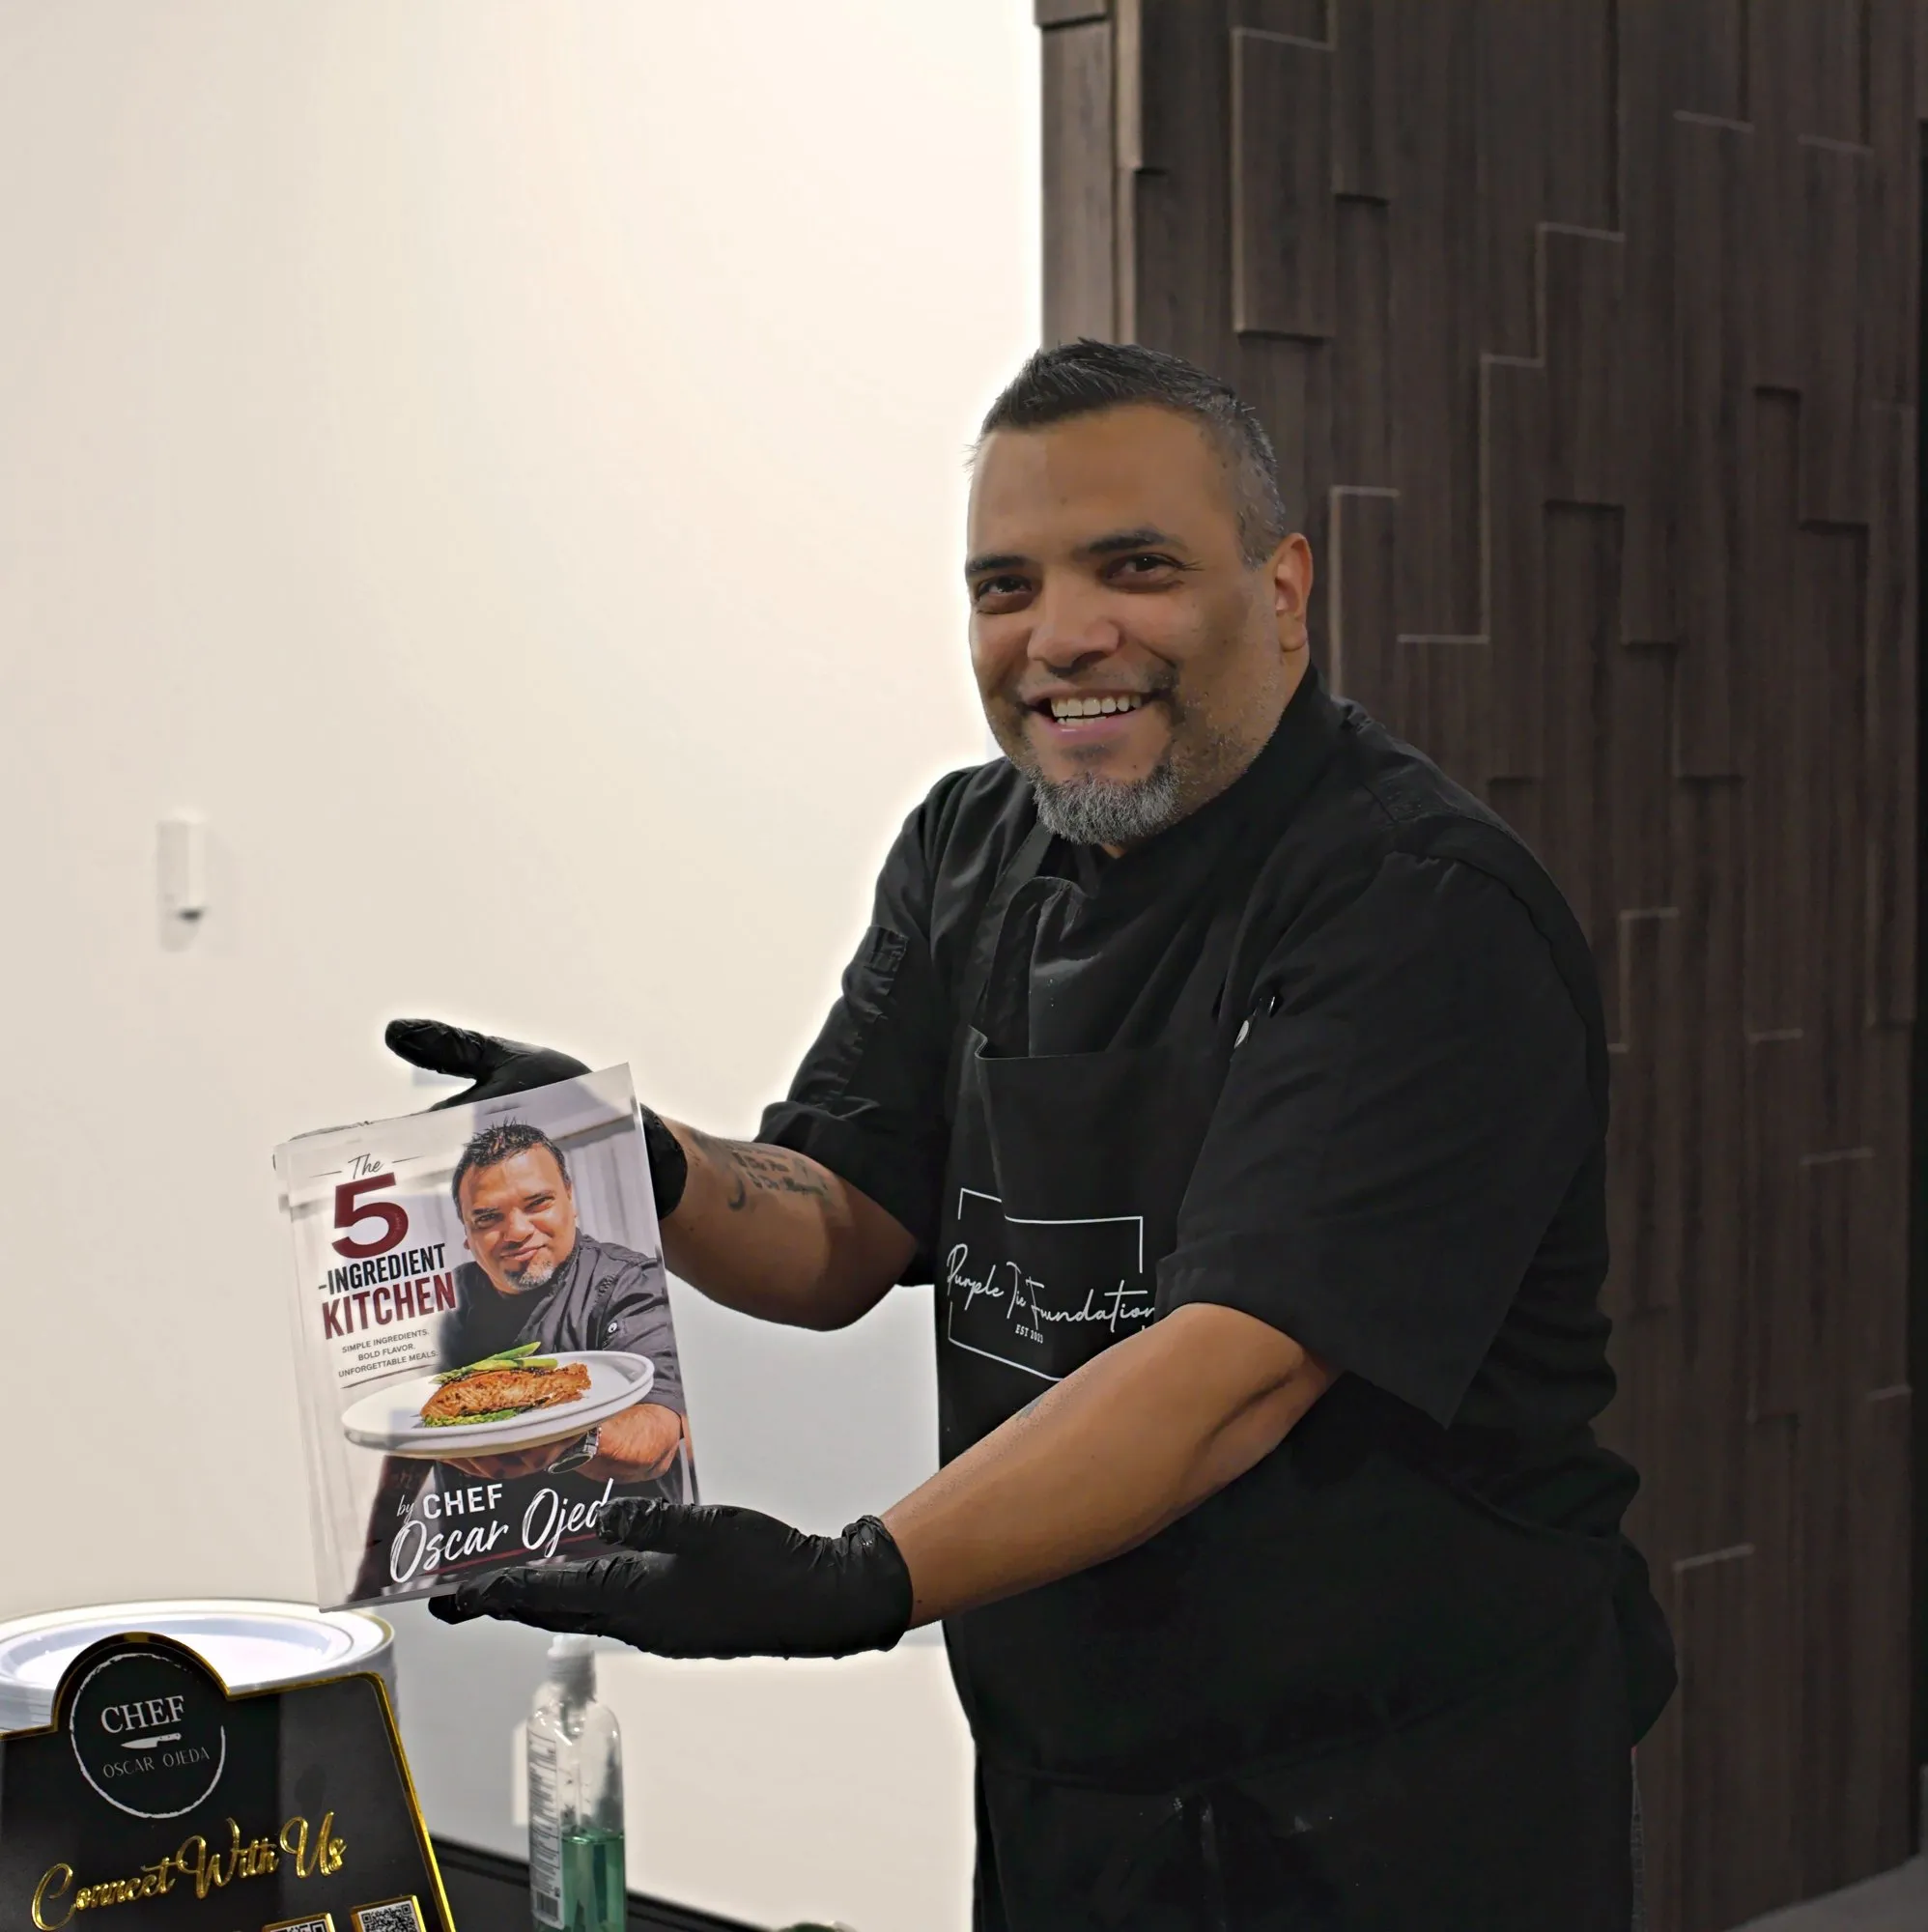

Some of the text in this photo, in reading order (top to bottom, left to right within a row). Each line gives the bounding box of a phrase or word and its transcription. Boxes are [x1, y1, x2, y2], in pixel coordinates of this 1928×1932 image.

[348, 1152, 383, 1179] The
[331, 1172, 409, 1259] 5
[947, 1243, 1005, 1311] Purple
[1007, 1261, 1027, 1320] Tie
[322, 1271, 457, 1341] KITCHEN
[342, 1328, 430, 1353] SIMPLE INGREDIENTS.
[1015, 1323, 1030, 1337] EST
[338, 1350, 439, 1378] UNFORGETTABLE MEALS.
[358, 1343, 416, 1362] BOLD FLAVOR.
[397, 1483, 503, 1524] by CHEF
[389, 1477, 614, 1583] Oscar Ojed
[100, 1694, 185, 1734] CHEF
[102, 1747, 211, 1778] OSCAR OJEDA
[31, 1810, 348, 1931] Connect With Us
